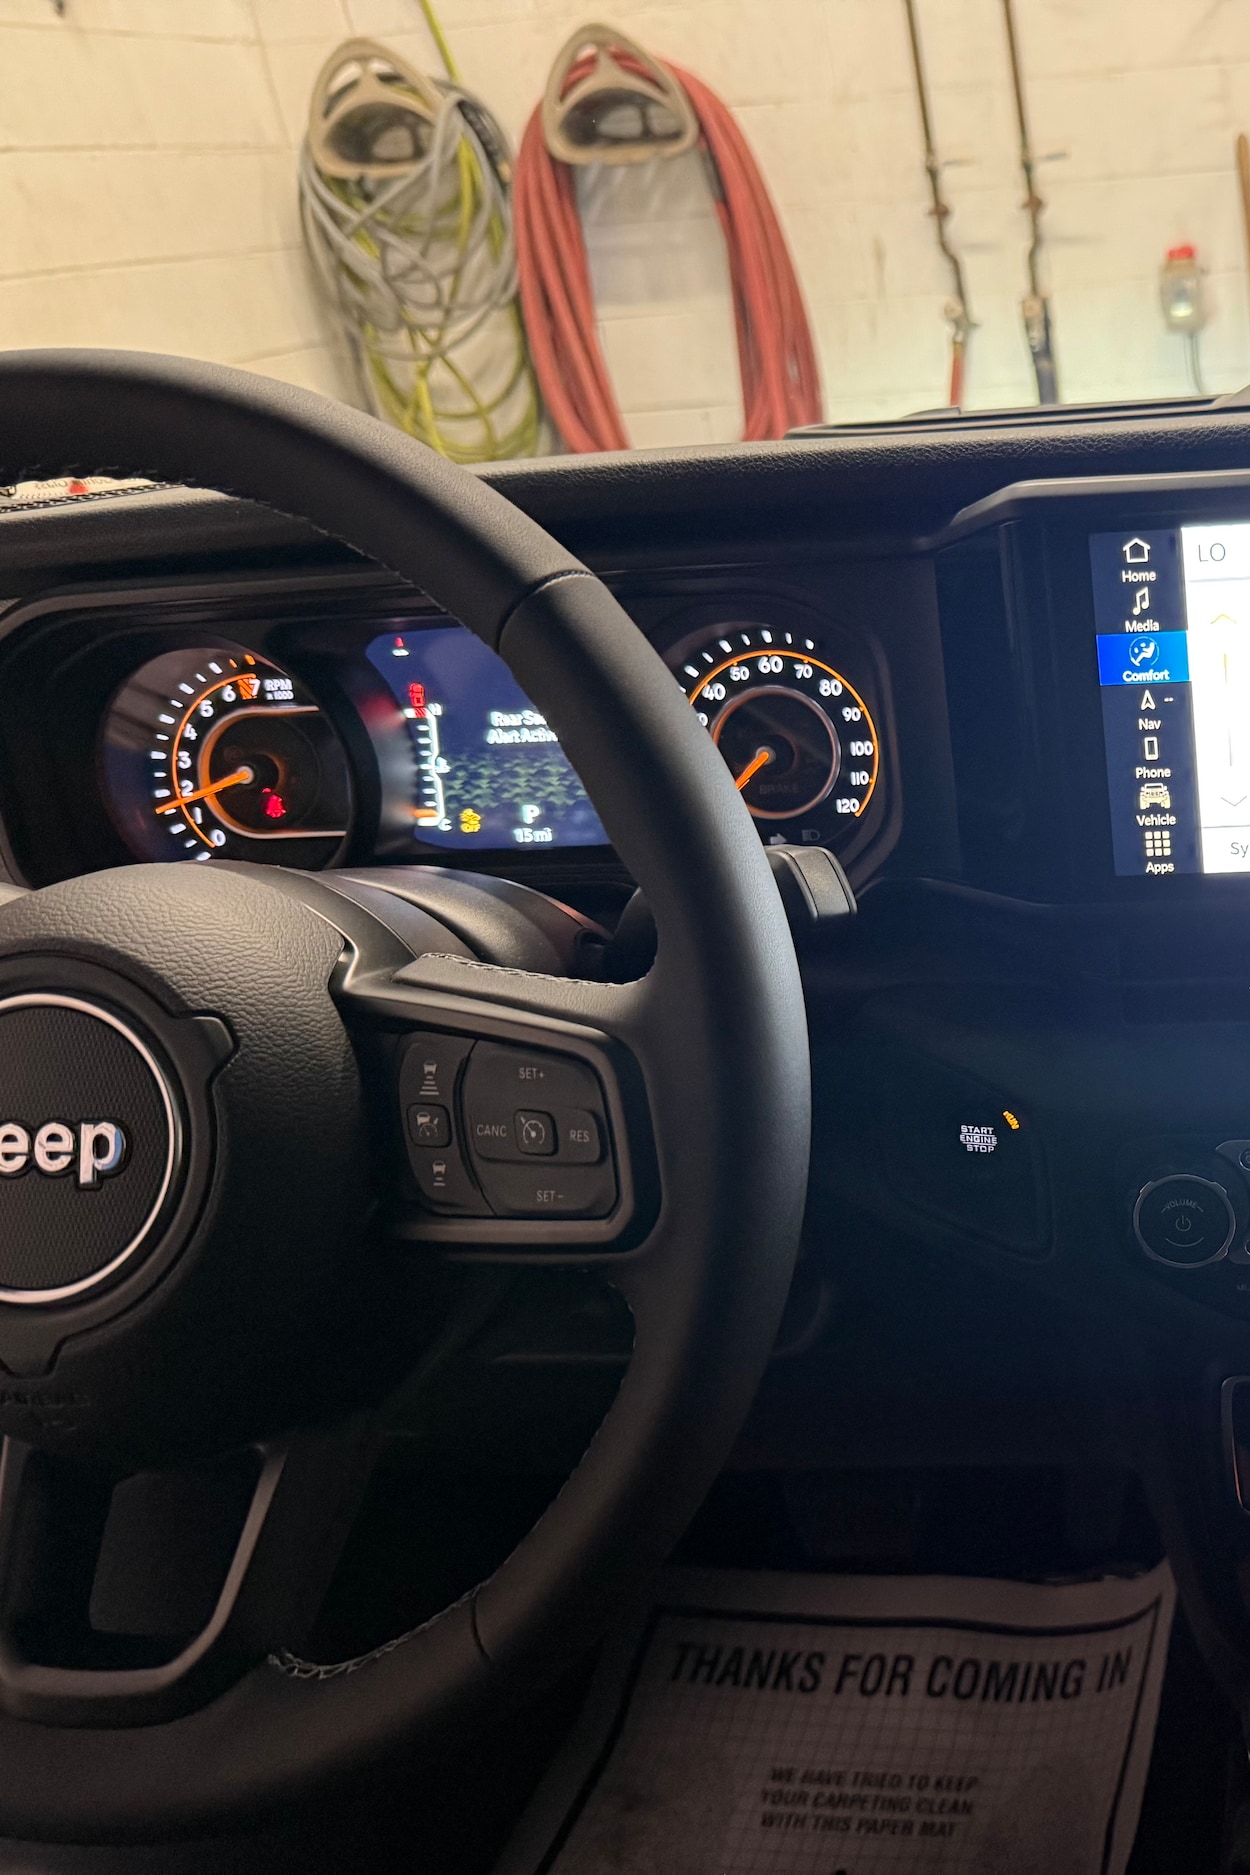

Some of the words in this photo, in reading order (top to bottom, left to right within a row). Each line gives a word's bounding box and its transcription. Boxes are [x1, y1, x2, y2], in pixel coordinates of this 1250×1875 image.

[1198, 542, 1226, 563] LO
[1121, 569, 1157, 583] Home
[1124, 619, 1160, 633] Media
[758, 656, 783, 673] 60
[794, 664, 813, 679] 70
[730, 666, 750, 681] 50
[1122, 668, 1170, 683] Comfort
[250, 679, 261, 696] 7
[264, 678, 293, 691] RPM
[702, 683, 726, 700] 40
[819, 679, 843, 697] 80
[221, 684, 237, 703] 6
[200, 700, 215, 718] 5
[842, 707, 861, 722] 90
[490, 711, 524, 727] Rear
[1138, 718, 1161, 731] Nav
[184, 723, 198, 741] 4
[850, 741, 873, 756] 100
[178, 751, 192, 769] 3
[850, 771, 869, 785] 110
[1135, 765, 1171, 779] Phone
[180, 780, 194, 798] 2
[836, 798, 860, 814] 120
[193, 807, 203, 825] 1
[521, 804, 540, 825] P
[1136, 813, 1176, 827] Vehicle
[210, 829, 227, 847] 0
[1146, 861, 1175, 875] Apps
[476, 1124, 507, 1137] CANC
[569, 1129, 590, 1142] RES
[960, 1124, 994, 1134] START
[959, 1134, 998, 1145] ENGINE
[966, 1144, 995, 1153] STOP
[1164, 1198, 1198, 1210] VOLUME
[670, 1642, 826, 1694] THANKS
[833, 1652, 915, 1697] FOR
[925, 1654, 1086, 1703] COMING
[1095, 1645, 1134, 1694] IN
[770, 1766, 800, 1784] WE
[802, 1768, 847, 1787] HAVE
[851, 1770, 901, 1790] TRIED
[907, 1773, 931, 1790] TO
[934, 1774, 979, 1792] KEEP
[761, 1789, 809, 1808] YOUR
[812, 1791, 911, 1814] CARPETING
[915, 1797, 975, 1816] CLEAN
[760, 1813, 808, 1831] WITH
[812, 1815, 851, 1833] THIS
[856, 1817, 913, 1837] PAPER
